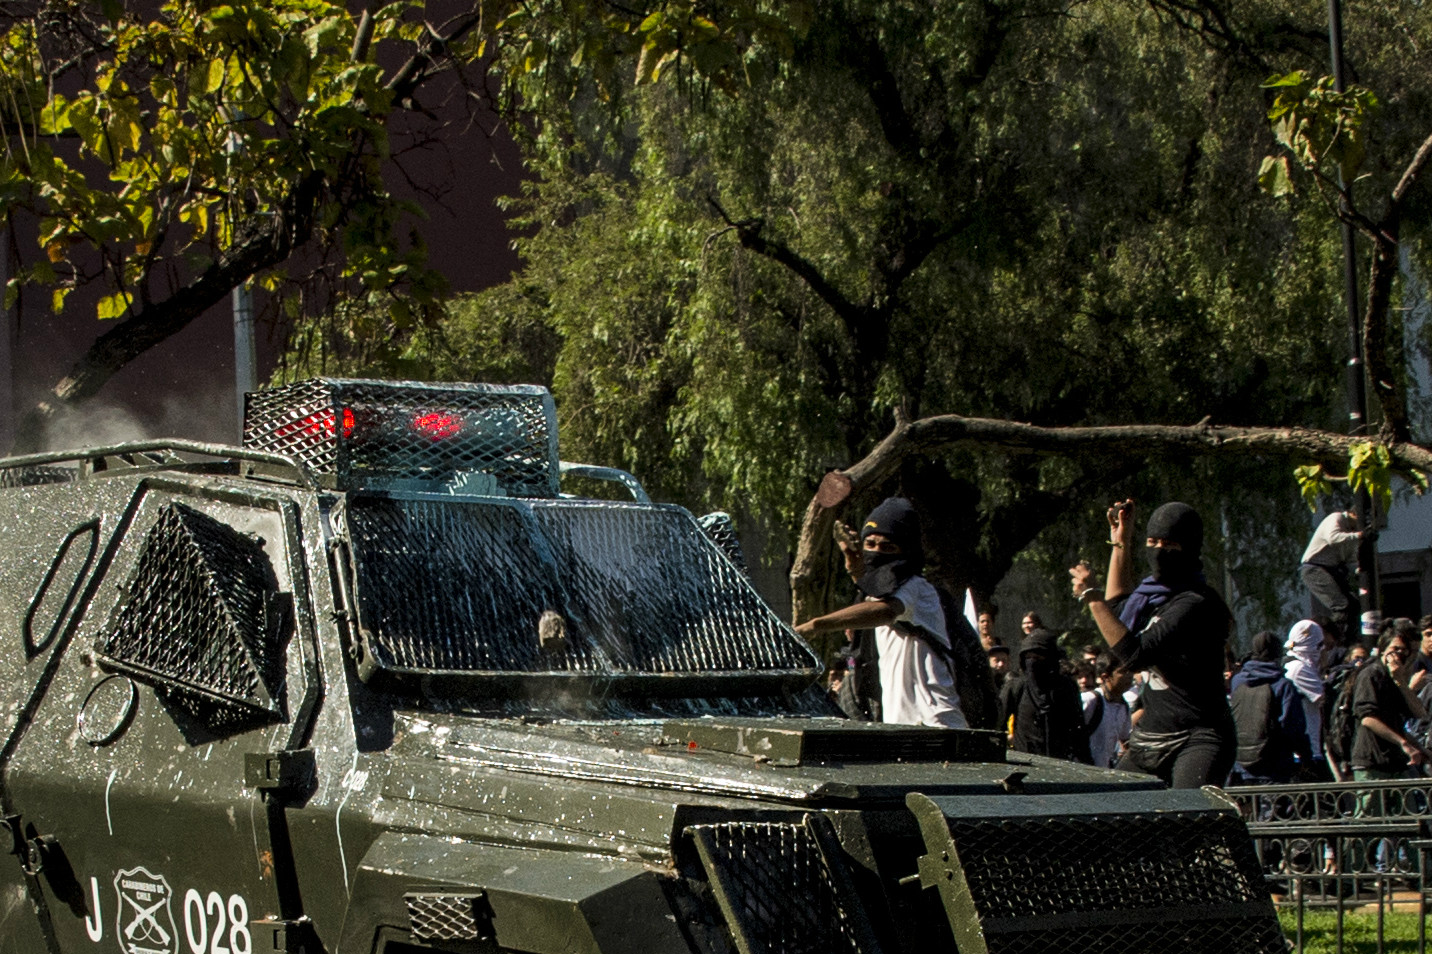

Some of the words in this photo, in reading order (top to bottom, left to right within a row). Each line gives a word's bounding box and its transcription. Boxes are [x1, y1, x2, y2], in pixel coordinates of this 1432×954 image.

[121, 879, 156, 893] CARABINEROS
[156, 884, 165, 894] DE
[136, 891, 152, 902] CHILE
[85, 877, 103, 942] J
